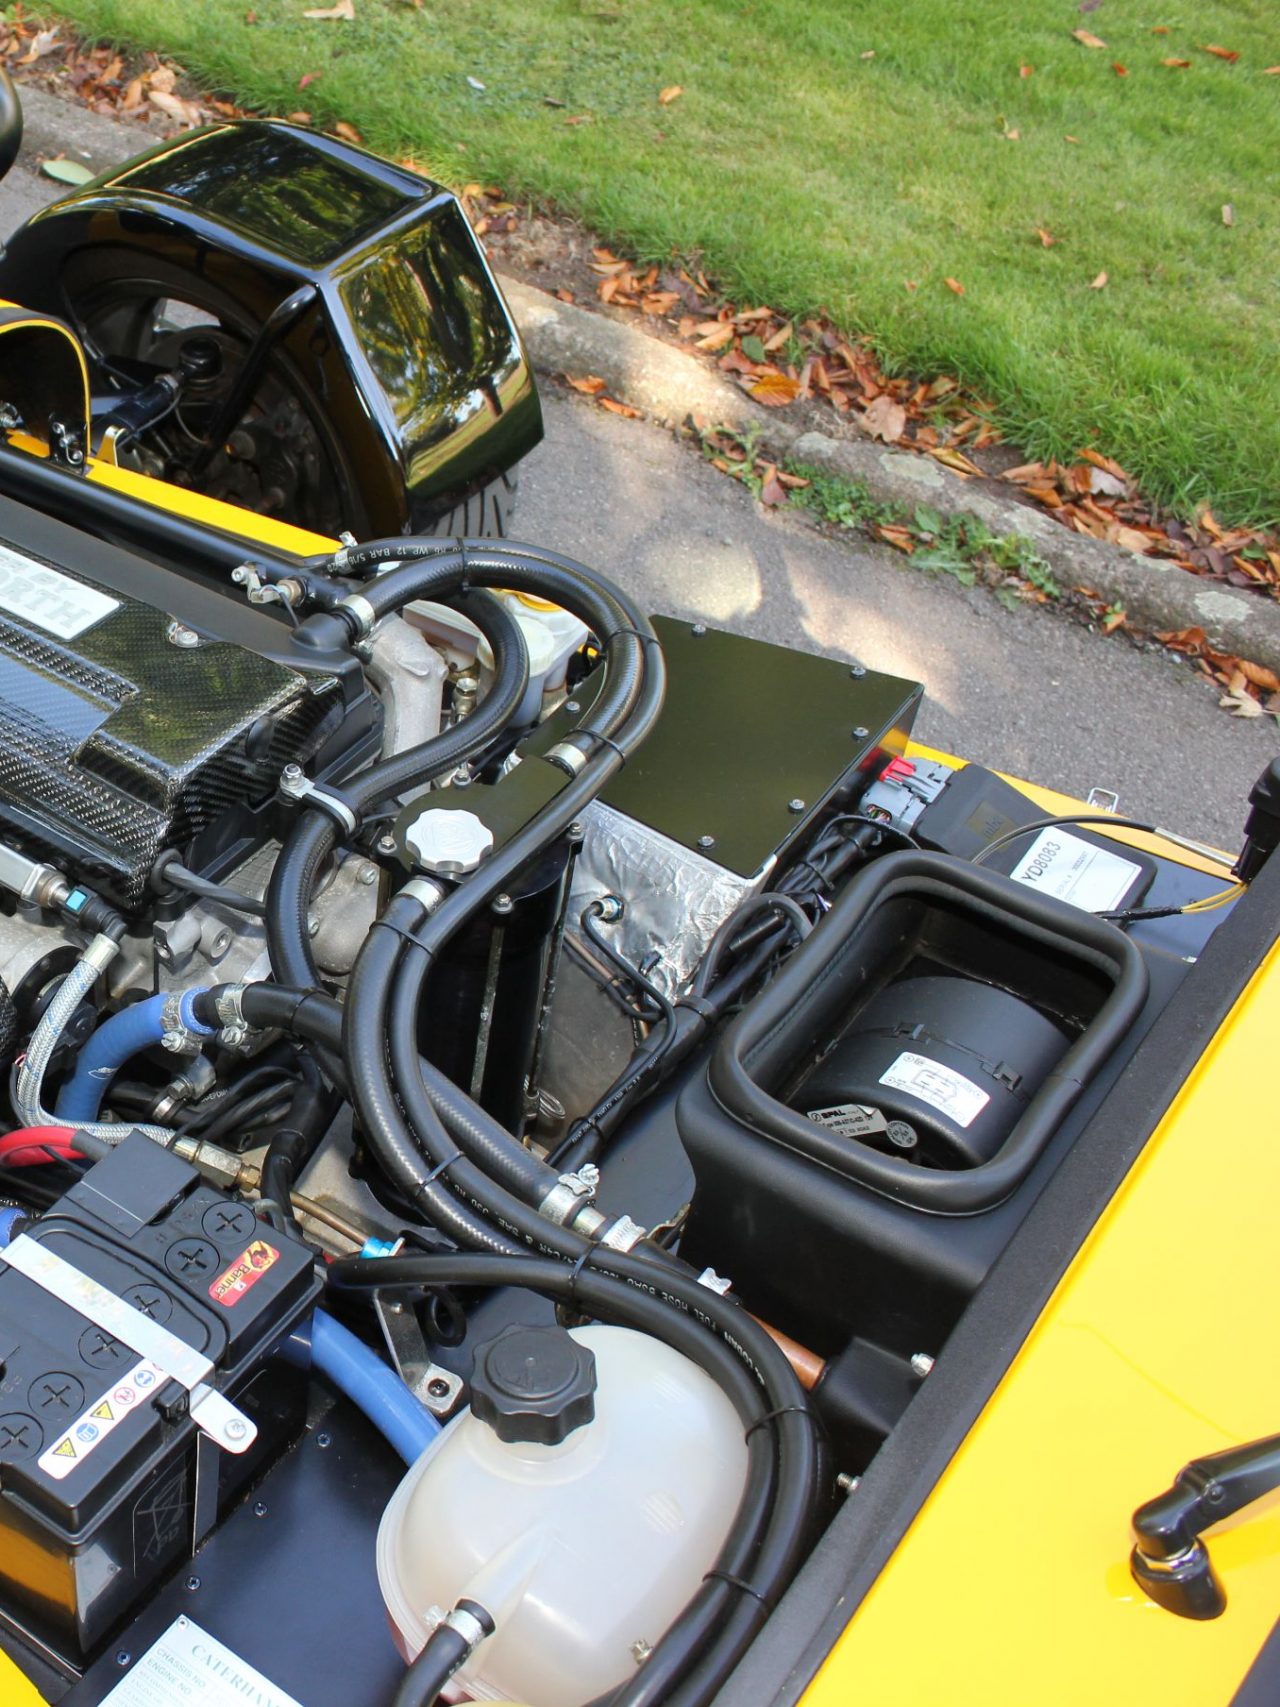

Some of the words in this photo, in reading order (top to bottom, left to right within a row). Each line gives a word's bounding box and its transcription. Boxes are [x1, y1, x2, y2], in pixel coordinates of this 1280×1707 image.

[370, 548, 390, 559] BAR
[1021, 841, 1061, 882] YD8083
[216, 1263, 251, 1299] Banner
[146, 1658, 177, 1685] ENGINE
[156, 1647, 193, 1679] CHASSIS
